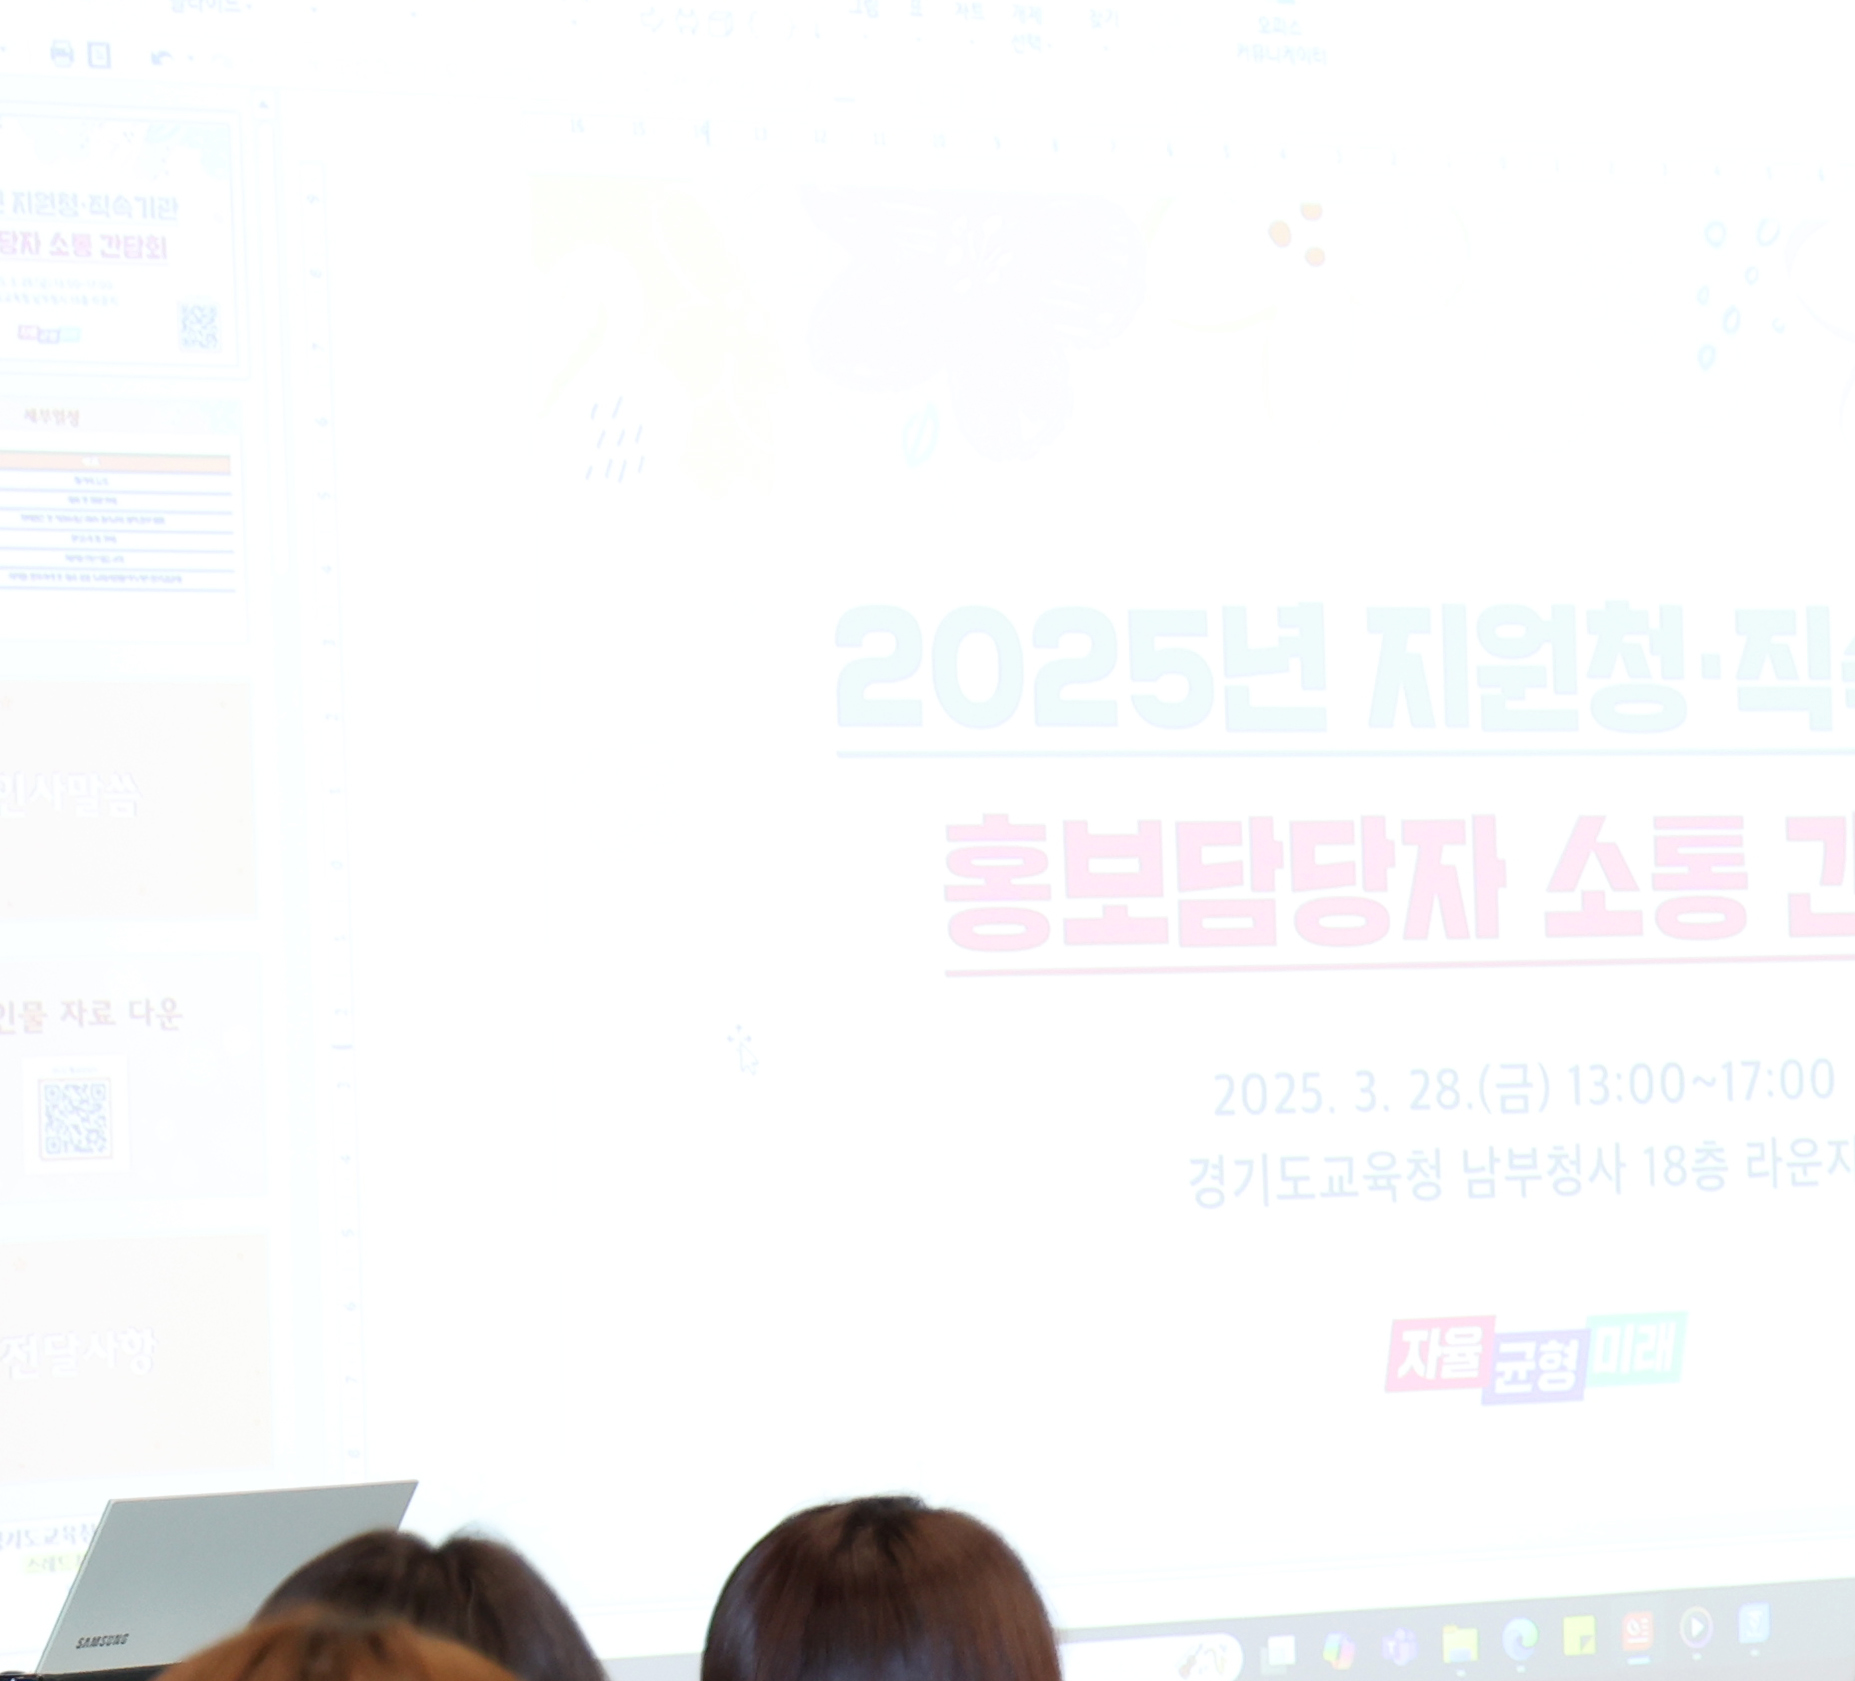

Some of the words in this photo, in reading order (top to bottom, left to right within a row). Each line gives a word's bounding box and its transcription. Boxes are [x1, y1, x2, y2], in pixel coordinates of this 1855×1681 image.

[834, 600, 1328, 733] 2025년
[942, 812, 1508, 953] 홍보담당자
[1543, 814, 1749, 941] 소통
[127, 996, 184, 1032] 다운
[1213, 1070, 1336, 1116] 2025.
[1567, 1056, 1835, 1106] 13:00~17:00
[1188, 1146, 1443, 1209] 경기도교육청
[1462, 1140, 1627, 1199] 남부청사
[1642, 1138, 1729, 1192] 18층
[1397, 1325, 1484, 1380] 자율
[1495, 1338, 1580, 1394] 균형
[1595, 1322, 1675, 1373] 미래
[75, 1633, 130, 1650] SAMSUNG
